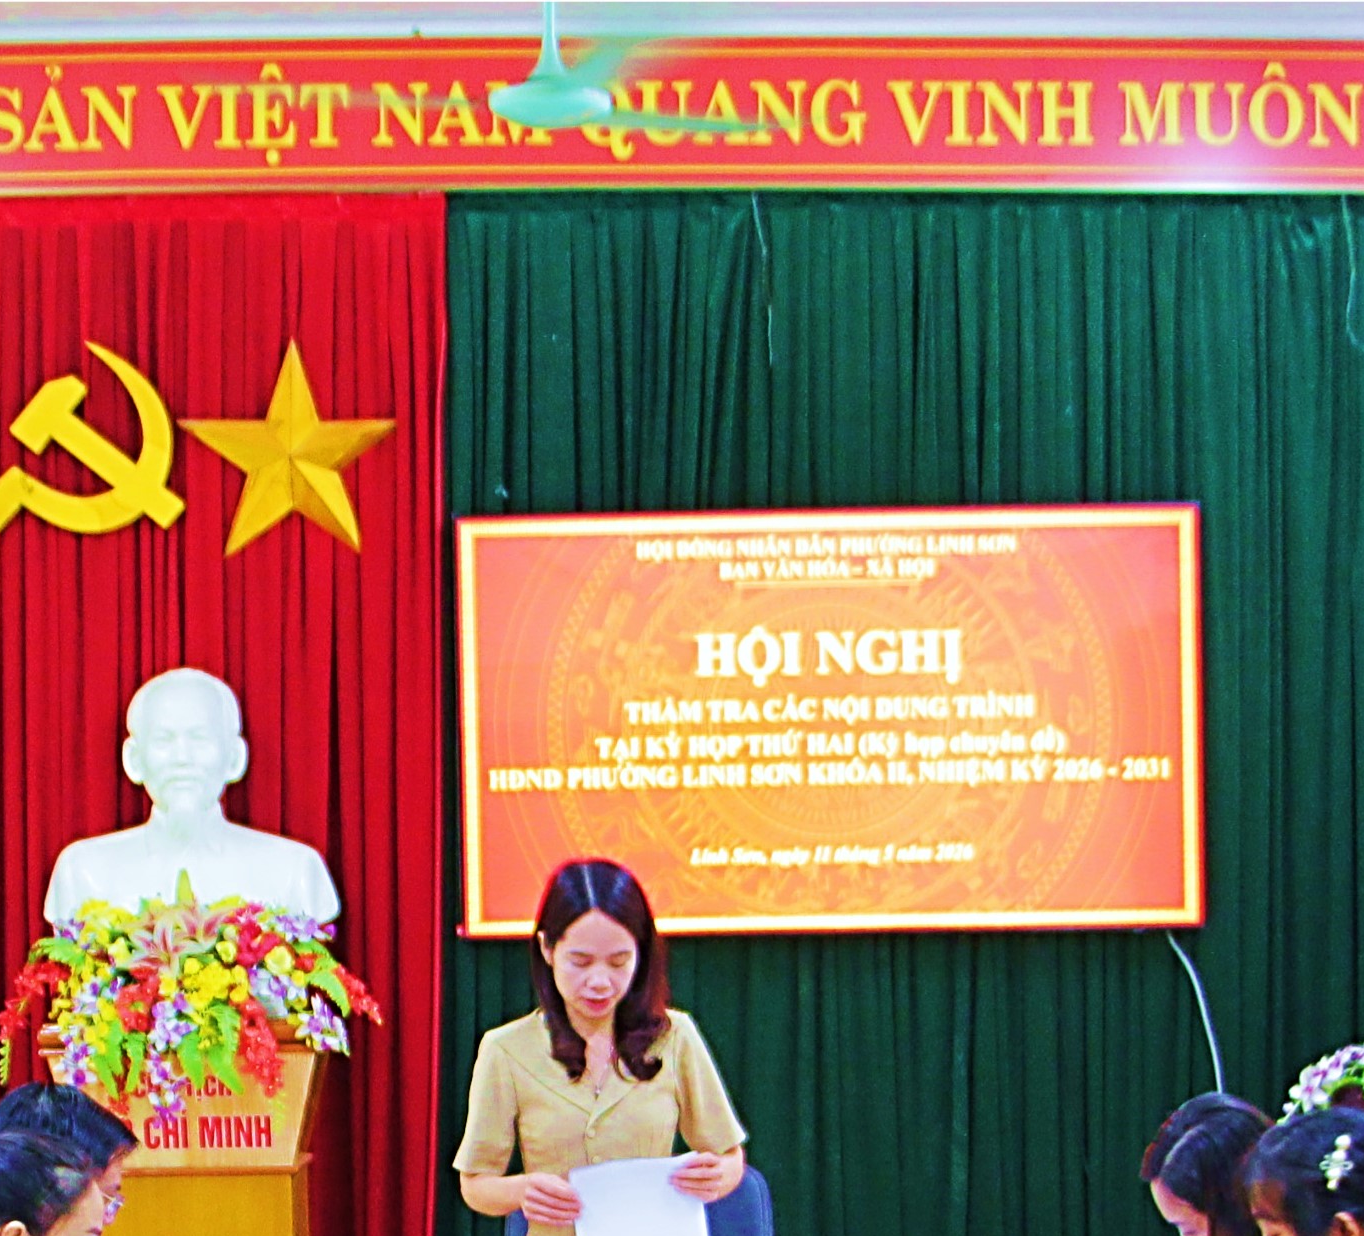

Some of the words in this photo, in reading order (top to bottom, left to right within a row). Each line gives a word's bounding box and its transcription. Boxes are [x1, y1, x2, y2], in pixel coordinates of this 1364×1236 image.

[158, 63, 350, 167] VIỆT
[580, 79, 868, 161] QUANG
[886, 81, 1095, 147] VINH
[1117, 62, 1363, 147] MUÔN
[636, 539, 673, 564] HỘI
[926, 534, 974, 555] LINH
[719, 560, 758, 581] BAN
[897, 557, 935, 580] HỘI
[695, 624, 801, 687] HỘI
[817, 628, 962, 684] NGHỊ
[706, 699, 759, 724] TRA
[763, 693, 816, 722] CÁC
[823, 694, 870, 726] NỘI
[875, 696, 949, 721] DUNG
[953, 689, 1035, 718] TRÌNH
[596, 736, 640, 763] TẠI
[688, 736, 745, 762] HỌP
[745, 729, 804, 757] THỨ
[807, 733, 852, 756] HAI
[904, 732, 946, 758] họp
[489, 768, 562, 791] HĐND
[568, 761, 676, 789] PHƯỜNG
[682, 764, 746, 788] LINH
[749, 763, 802, 786] SƠN
[919, 757, 1006, 787] NHIỆM
[1052, 758, 1103, 782] 2026
[1121, 757, 1171, 781] 2031
[689, 847, 729, 866] Linh
[144, 1108, 189, 1149] CHÍ
[197, 1115, 272, 1149] MINH
